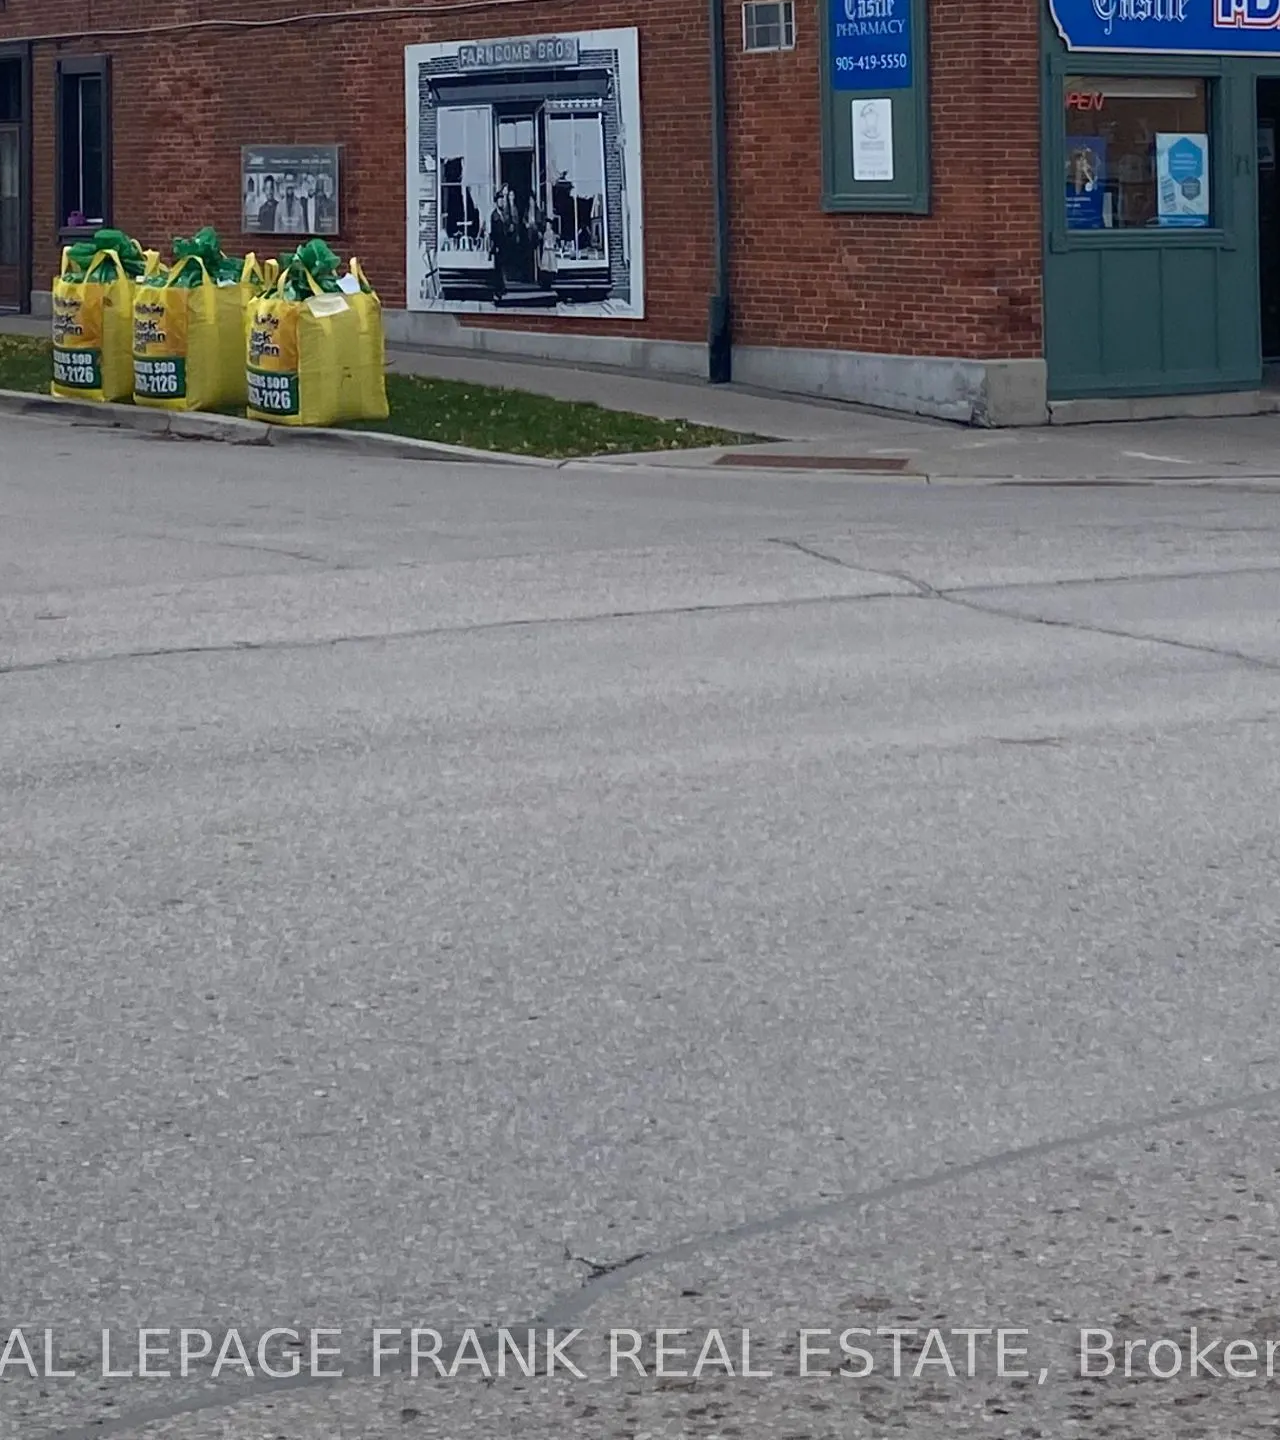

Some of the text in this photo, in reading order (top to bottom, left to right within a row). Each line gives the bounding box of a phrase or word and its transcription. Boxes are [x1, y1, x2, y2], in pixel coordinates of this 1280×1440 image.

[836, 19, 906, 38] PHARMACY
[835, 53, 907, 71] 905-419-5550
[1065, 91, 1104, 110] PEN
[72, 353, 92, 365] SOD
[154, 362, 176, 374] SOD
[266, 376, 289, 389] SOD
